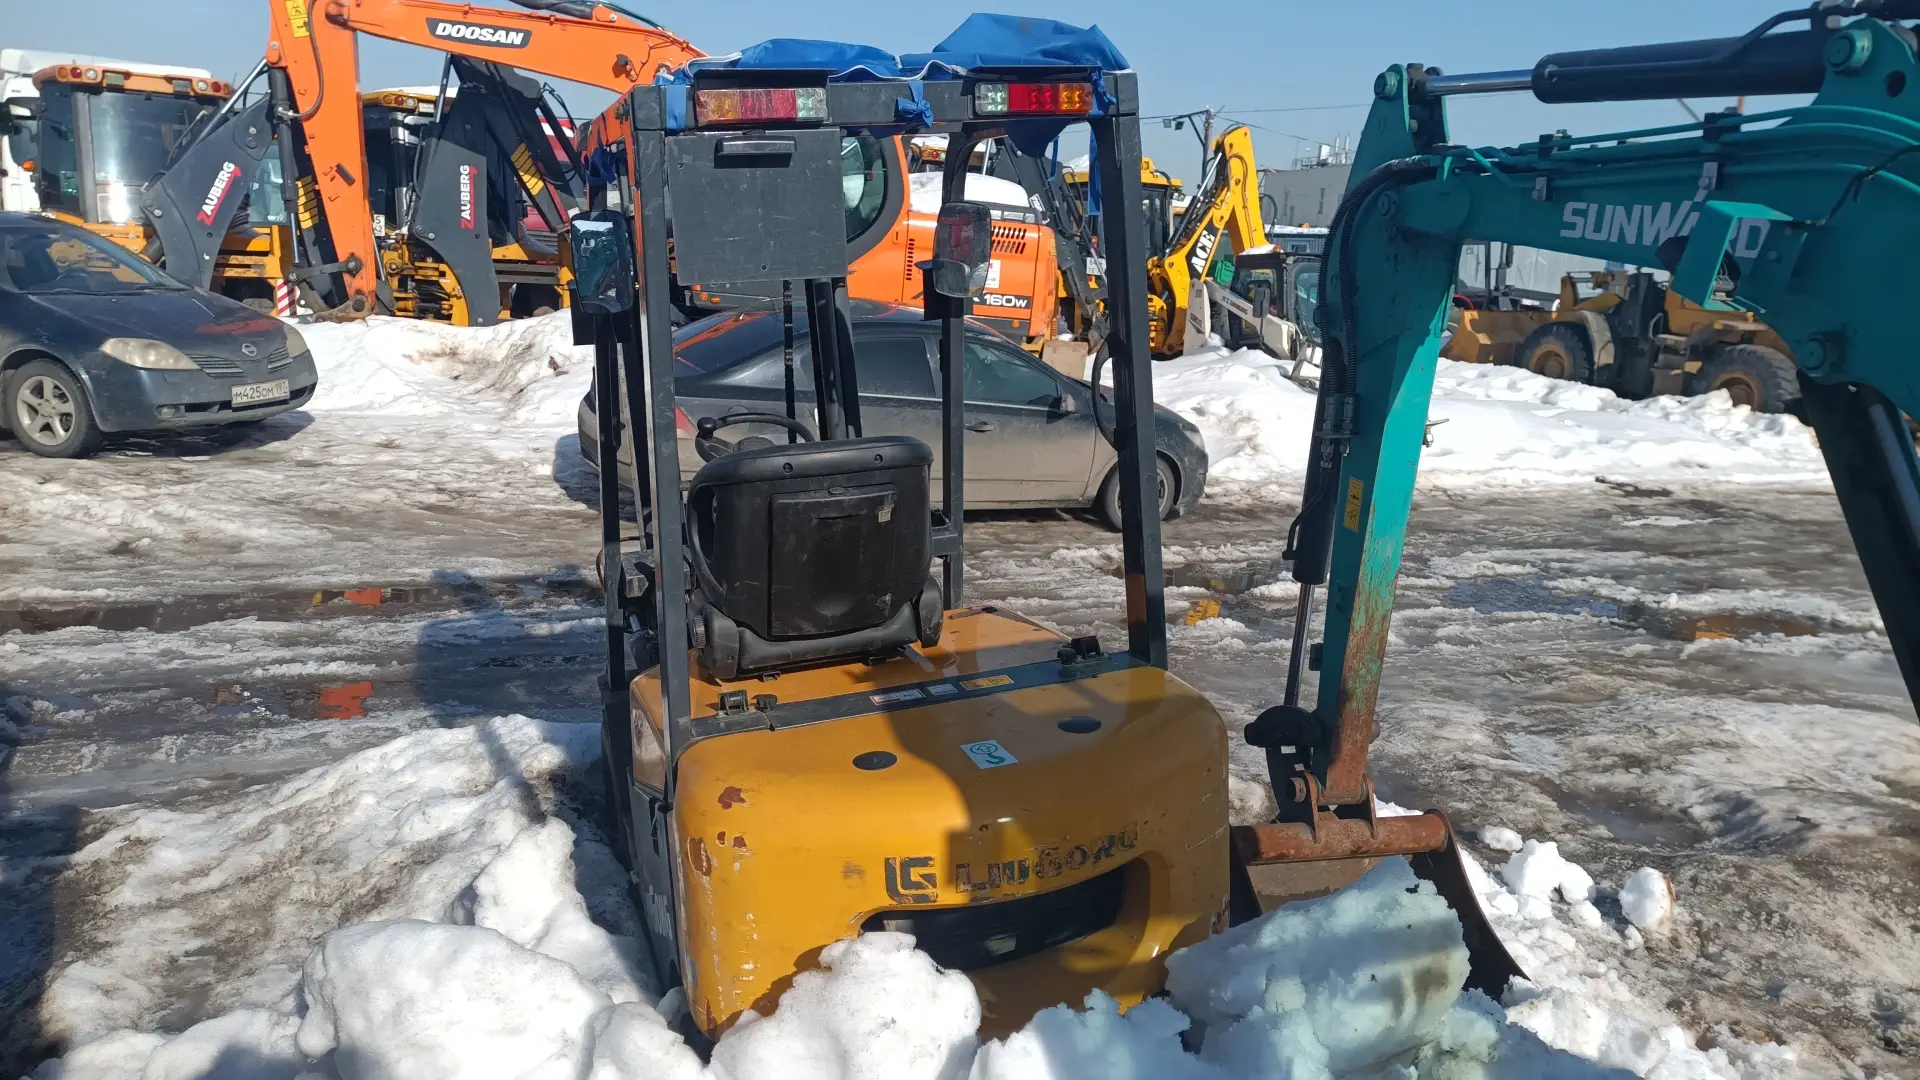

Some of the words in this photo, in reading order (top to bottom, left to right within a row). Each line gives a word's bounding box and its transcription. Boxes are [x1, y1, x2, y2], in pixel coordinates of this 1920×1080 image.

[435, 22, 524, 45] DOOSAN
[197, 161, 242, 226] ZAUBERG
[460, 165, 479, 230] ZAUBERG
[1190, 230, 1215, 274] ACE
[1560, 198, 1771, 259] SUNWD
